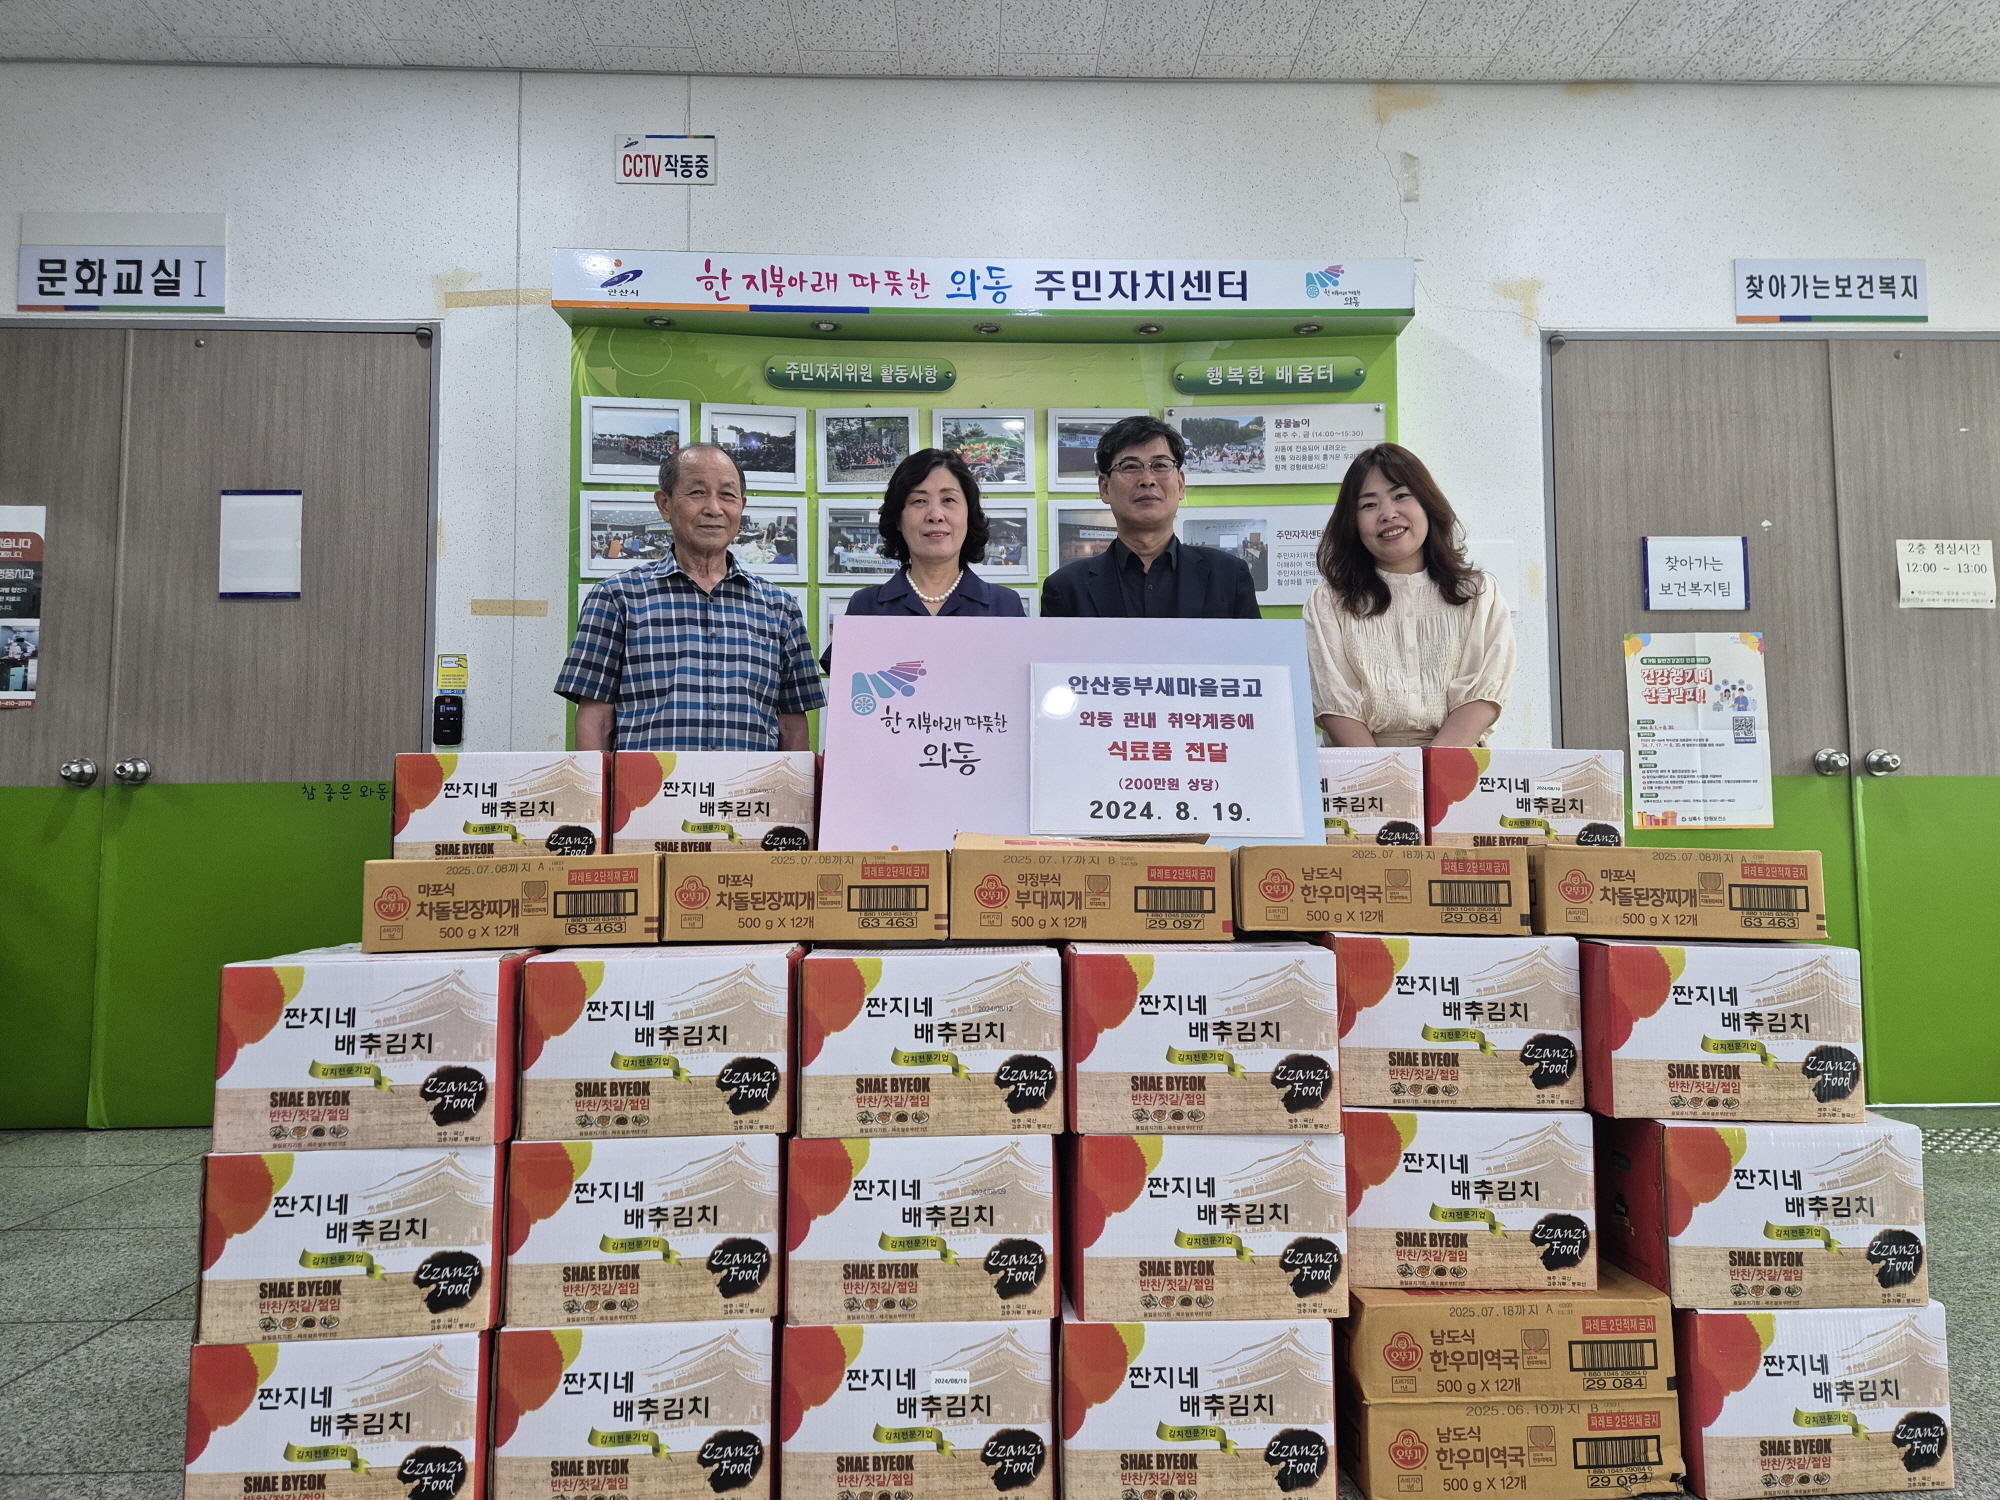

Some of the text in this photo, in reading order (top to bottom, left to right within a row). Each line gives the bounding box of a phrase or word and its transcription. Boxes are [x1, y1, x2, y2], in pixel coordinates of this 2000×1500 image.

[37, 258, 183, 297] 문화교실
[696, 259, 1249, 304] 한 지붕아래 따뜻한 와동 주민자치센터
[1745, 274, 1918, 300] 찾아가는보건복지
[608, 288, 639, 297] 안산시
[785, 361, 938, 384] 주민자치위원 활동사항
[1206, 363, 1335, 386] 행복한 배움터
[1274, 418, 1310, 428] 풍물놀이
[1908, 542, 1981, 556] 2층 점심시간
[1665, 555, 1724, 572] 찾아가는
[1906, 562, 1937, 573] 12:00
[1957, 563, 1987, 573] 13:00
[1659, 581, 1731, 597] 보건복지팀
[1068, 675, 1263, 699] 안산동부새마을금고
[1641, 668, 1713, 685] 건강챙기며
[1641, 687, 1706, 704] 선물받자!
[880, 705, 1008, 736] 한 지붕아래 따뜻한
[1079, 711, 1255, 731] 와동 관내 취약계층에
[918, 742, 982, 776] 와동
[1108, 741, 1229, 764] 식료품 전달
[302, 783, 389, 802] 참 좋은 와동
[443, 781, 497, 798] 짠지네
[662, 780, 715, 797] 짠지네
[1118, 776, 1220, 793] (200만원 상당)
[1479, 776, 1530, 795] 짠지네
[481, 800, 555, 818] 배추김치
[699, 800, 770, 817] 배추김치
[1090, 799, 1252, 823] 2024. 8. 19.
[1516, 797, 1584, 814] 배추김치
[537, 862, 545, 871] A
[570, 870, 593, 883] 파레트
[622, 869, 636, 882] 금지
[1301, 866, 1342, 881] 남도식
[1600, 868, 1636, 883] 마포식
[417, 883, 455, 897] 마포식
[717, 873, 753, 887] 마포식
[1017, 872, 1061, 887] 의정부식
[715, 890, 815, 912] 차돌된장찌개
[1015, 889, 1083, 910] 부대찌개
[1300, 884, 1383, 905] 한우미역국
[1600, 886, 1697, 908] 차돌된장찌개
[380, 902, 405, 913] 오뚜기
[416, 898, 520, 921] 차돌된장찌개
[439, 924, 519, 940] 500 g X 12개
[568, 922, 624, 934] 63 463
[1395, 975, 1459, 996] 짠지네
[1672, 985, 1738, 1007] 짠지네
[585, 1000, 654, 1022] 짠지네
[865, 996, 933, 1018] 짠지네
[1138, 994, 1207, 1016] 짠지네
[1442, 1001, 1528, 1021] 배추김치
[283, 1006, 356, 1029] 짠지네
[1721, 1011, 1810, 1033] 배추김치
[634, 1024, 727, 1047] 배추김치
[914, 1021, 1004, 1043] 배추김치
[1188, 1020, 1281, 1042] 배추김치
[335, 1032, 432, 1055] 배추김치
[321, 1065, 371, 1076] 김치전문기업
[425, 1075, 485, 1094] Zzanzi
[269, 1090, 350, 1108] SHAE BYEOK
[443, 1093, 476, 1113] Food
[269, 1108, 349, 1122] 반찬/젓갈/절임
[1401, 1152, 1469, 1175] 짠지네
[852, 1179, 921, 1201] 짠지네
[1147, 1176, 1216, 1198] 짠지네
[1733, 1168, 1802, 1190] 짠지네
[574, 1181, 643, 1204] 짠지네
[1451, 1180, 1539, 1201] 배추김치
[272, 1193, 349, 1218] 짠지네
[624, 1204, 718, 1229] 배추김치
[902, 1204, 994, 1228] 배추김치
[1197, 1203, 1289, 1225] 배추김치
[1785, 1196, 1874, 1218] 배추김치
[326, 1217, 427, 1243] 배추김치
[1185, 1235, 1233, 1246] 김치전문기업
[1284, 1248, 1339, 1265] Zzanzi
[1139, 1260, 1214, 1277] SHAE BYEOK
[1301, 1265, 1333, 1285] Food
[1139, 1278, 1214, 1292] 반찬/젓갈/절임
[1430, 1329, 1475, 1345] 남도식
[1429, 1348, 1520, 1372] 한우미역국
[1763, 1353, 1829, 1376] 짠지네
[562, 1371, 633, 1396] 짠지네
[846, 1368, 916, 1391] 짠지네
[934, 1377, 968, 1385] 2024/08/10
[1128, 1366, 1198, 1389] 짠지네
[257, 1385, 333, 1410] 짠지네
[1813, 1379, 1899, 1404] 배추김치
[613, 1395, 709, 1422] 배추김치
[896, 1394, 991, 1418] 배추김치
[1179, 1393, 1274, 1417] 배추김치
[311, 1411, 410, 1437] 배추김치
[1436, 1426, 1481, 1442] 남도식
[1436, 1446, 1525, 1469] 한우미역국
